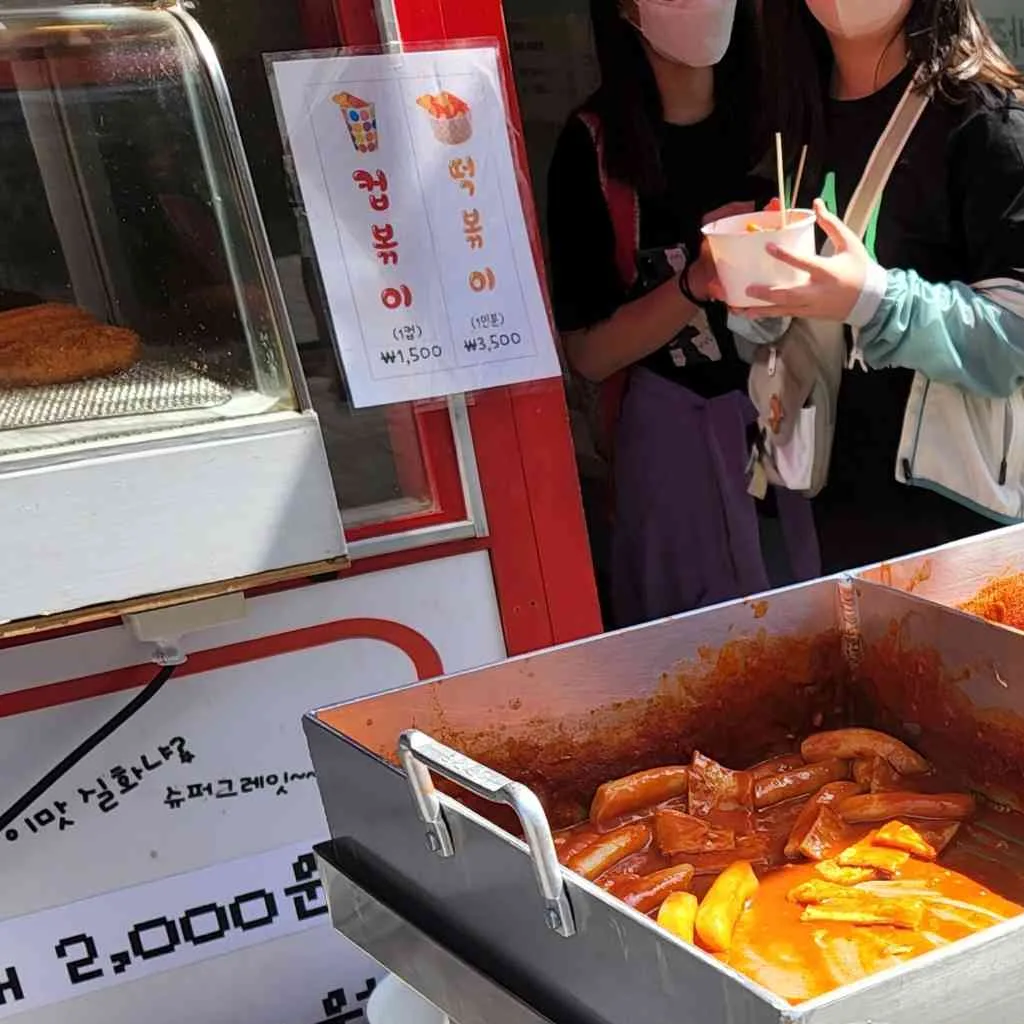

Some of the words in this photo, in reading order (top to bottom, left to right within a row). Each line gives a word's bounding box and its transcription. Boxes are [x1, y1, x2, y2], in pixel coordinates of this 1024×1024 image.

[471, 312, 505, 329] (1인분)
[463, 331, 521, 354] ₩3,500
[380, 345, 443, 367] ₩1,500
[4, 801, 75, 842] 이맛
[77, 736, 196, 813] 실화냐?
